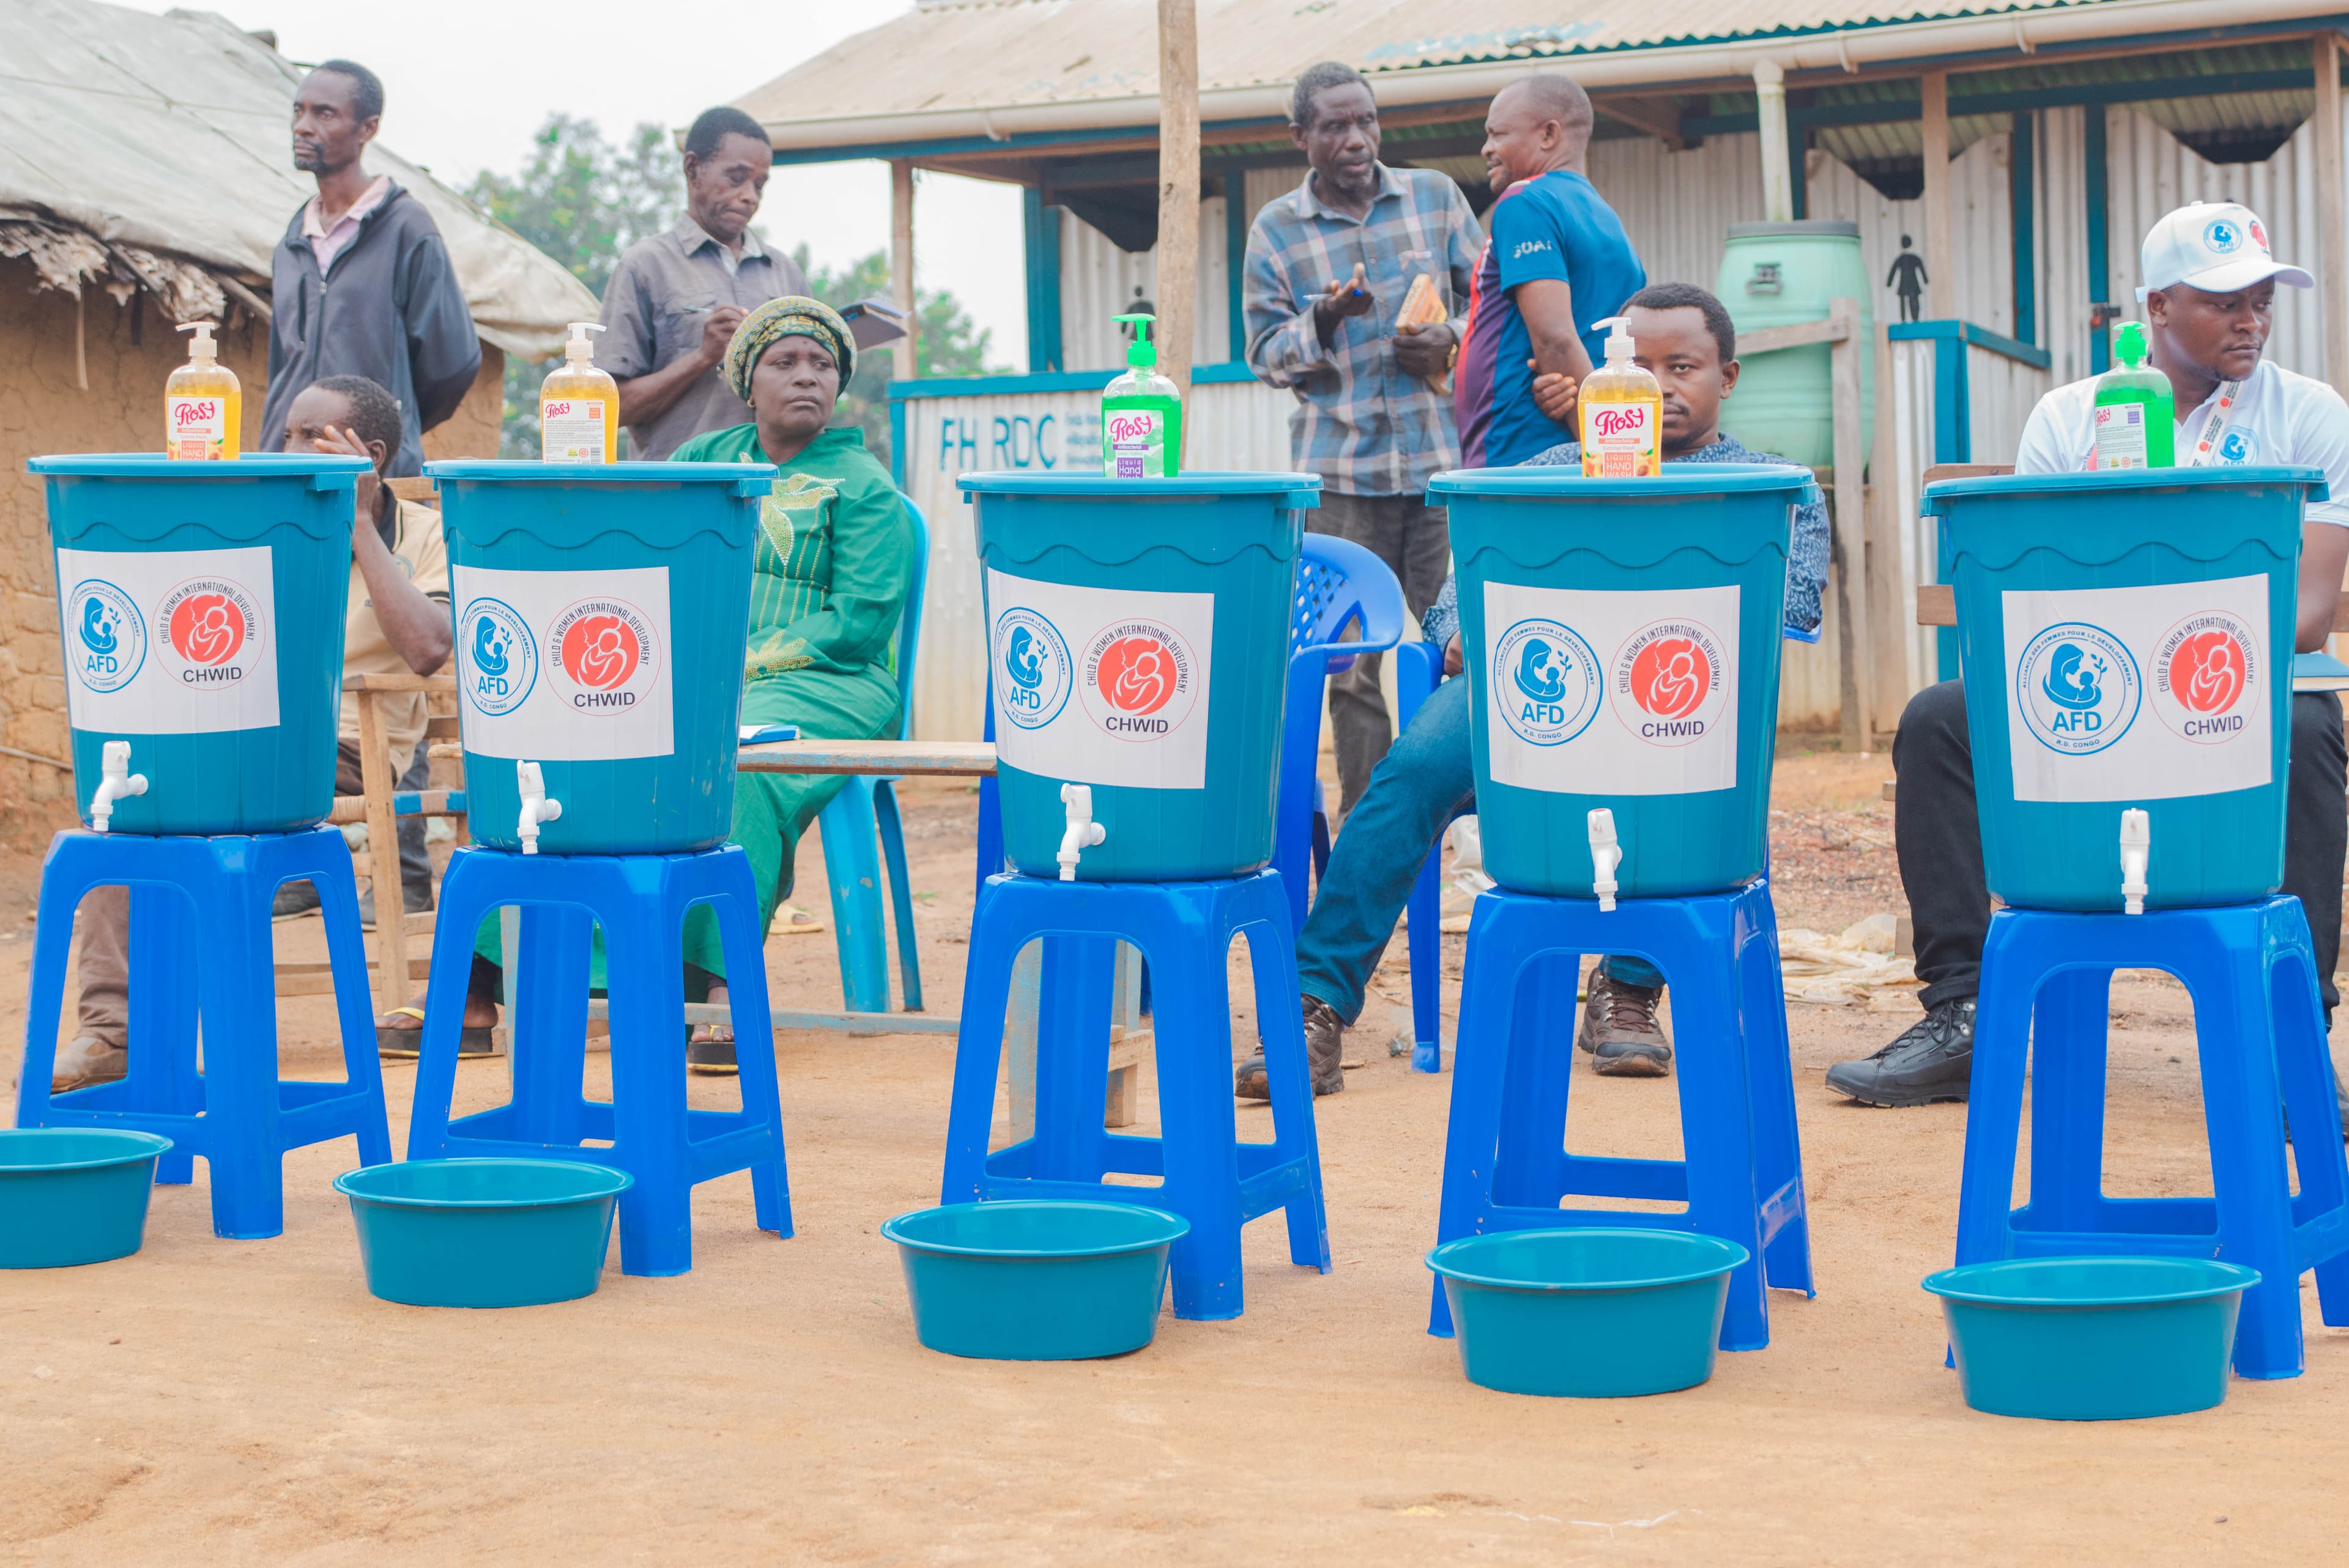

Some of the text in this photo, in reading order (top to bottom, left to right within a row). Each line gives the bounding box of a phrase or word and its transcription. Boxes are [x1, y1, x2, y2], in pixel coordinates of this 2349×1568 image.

[940, 414, 1057, 471] FH RDC
[1119, 465, 1141, 474] Hand
[1606, 462, 1631, 470] HAND
[183, 582, 236, 598] INTERNATIONAL
[163, 591, 184, 615] WOMEN
[574, 602, 630, 620] INTERNATIONAL
[234, 594, 255, 641] DEVELOPMENT
[555, 612, 576, 637] WOMEN
[2184, 617, 2238, 636] INTERNATIONAL
[160, 623, 171, 644] CHILD
[628, 616, 650, 665] DEVELOPMENT
[1115, 624, 1171, 645] INTERNATIONAL
[1514, 626, 1535, 637] FEMMES
[1647, 625, 1704, 644] INTERNATIONAL
[1091, 631, 1116, 656] WOMEN
[1624, 635, 1648, 661] WOMEN
[2161, 630, 2186, 658] WOMEN
[87, 655, 118, 673] AFD
[551, 645, 562, 667] CHILD
[1701, 639, 1720, 691] DEVELOPMENT
[2022, 656, 2033, 688] ALLIANCE
[2032, 645, 2041, 656] DES
[2041, 631, 2066, 645] FEMMES
[2236, 630, 2254, 685] DEVELOPMENT
[183, 667, 242, 682] CHWID
[1087, 664, 1097, 686] CHILD
[1168, 641, 1188, 694] DEVELOPMENT
[478, 675, 508, 696] AFD
[1619, 672, 1630, 694] CHILD
[2158, 668, 2170, 693] CHILD
[574, 692, 636, 707] CHWID
[1010, 686, 1041, 709] AFD
[1521, 702, 1565, 724] AFD
[2052, 711, 2102, 732] AFD
[1105, 716, 1168, 733] CHWID
[1524, 729, 1536, 737] R.D.
[1641, 721, 1704, 737] CHWID
[2184, 715, 2243, 736] CHWID
[2056, 739, 2100, 748] R.D. CONGO
